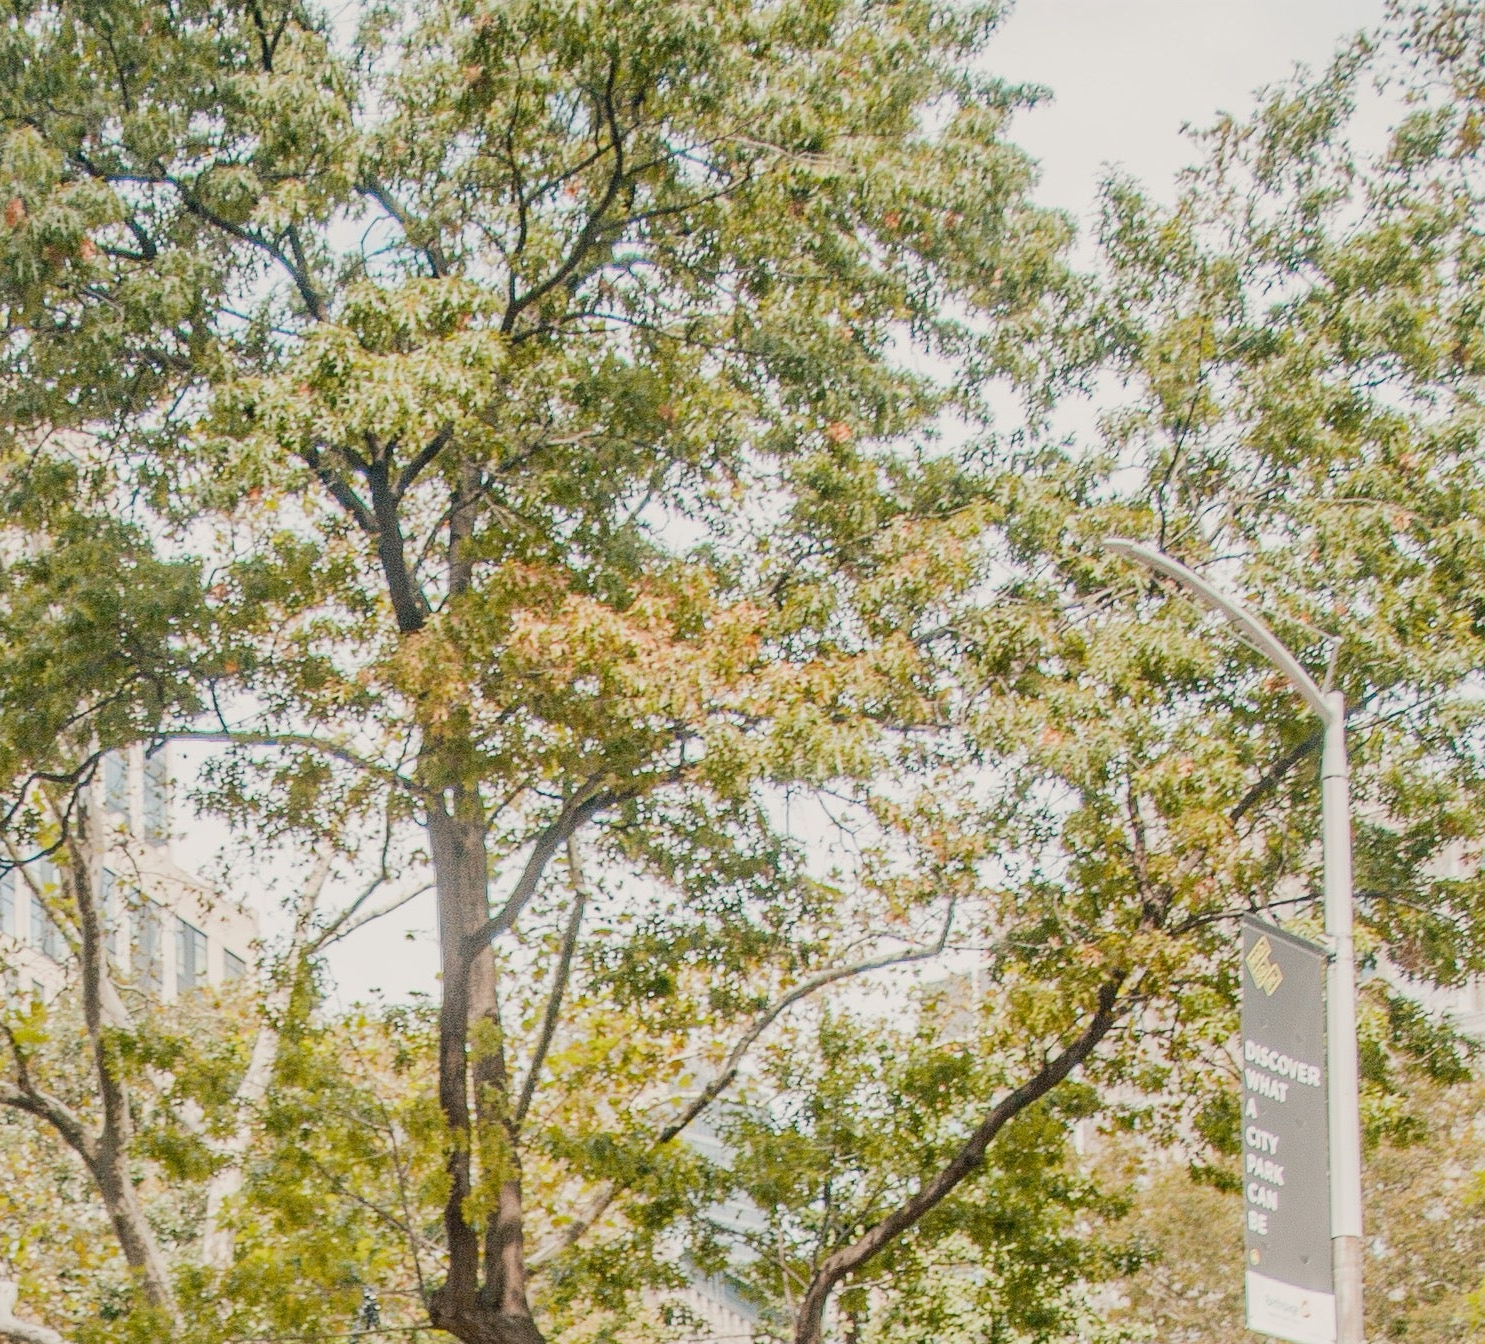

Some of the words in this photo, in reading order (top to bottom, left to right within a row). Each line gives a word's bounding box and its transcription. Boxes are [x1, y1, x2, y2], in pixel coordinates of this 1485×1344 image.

[1244, 1039, 1321, 1088] DISCOVER
[1244, 1067, 1289, 1104] WHAT
[1244, 1097, 1258, 1120] A
[1244, 1125, 1280, 1155] CITY
[1246, 1153, 1285, 1187] PARK
[1246, 1182, 1279, 1212] CAN
[1247, 1209, 1268, 1236] BE
